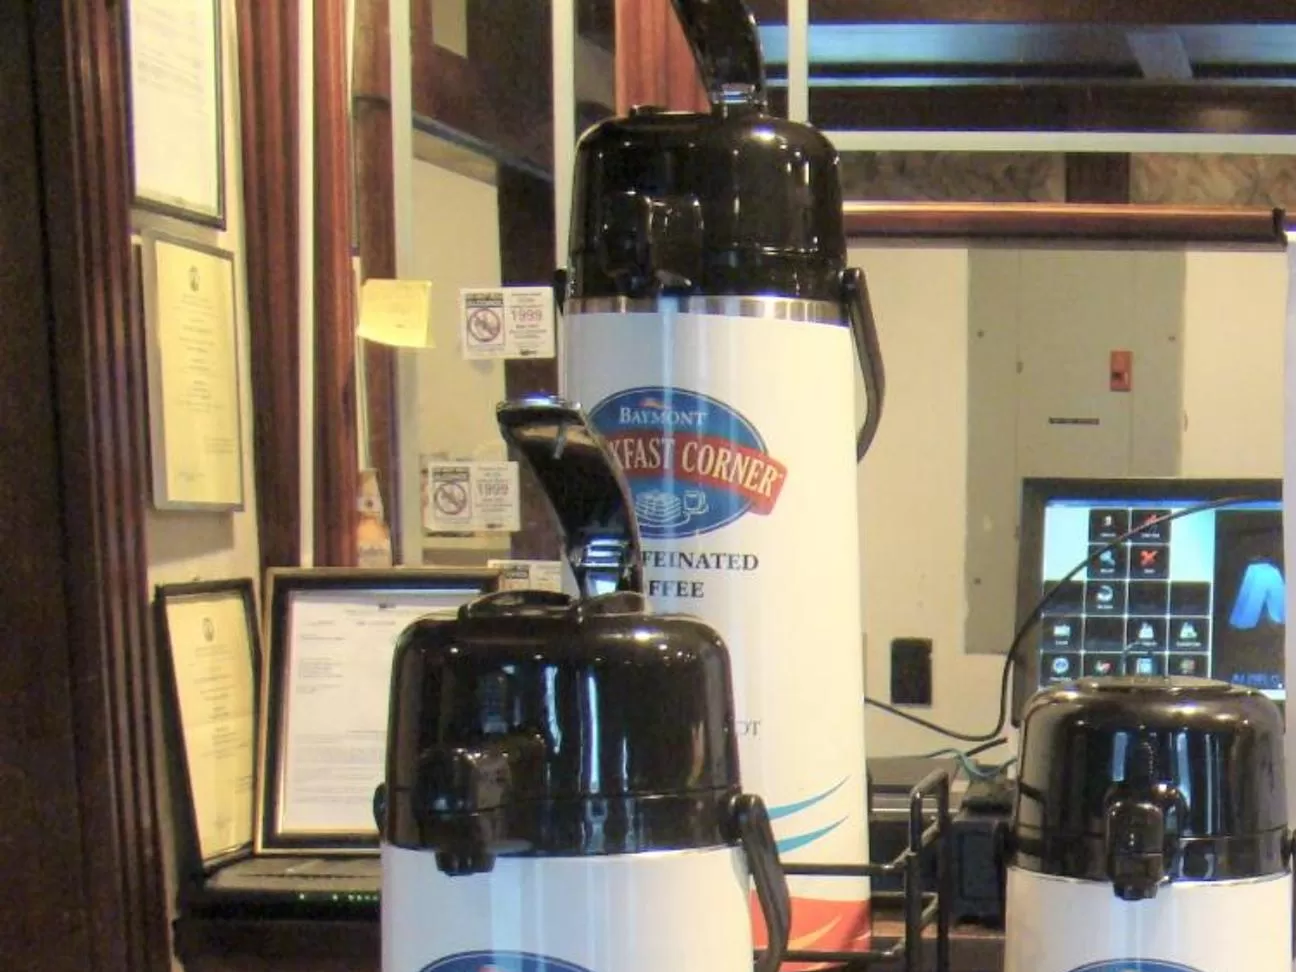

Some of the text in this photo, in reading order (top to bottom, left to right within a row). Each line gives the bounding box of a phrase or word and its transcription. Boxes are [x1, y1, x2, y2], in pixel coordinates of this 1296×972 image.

[618, 407, 709, 426] BAYMONT
[606, 437, 782, 498] KFAST CORNER
[648, 579, 705, 600] FFEE
